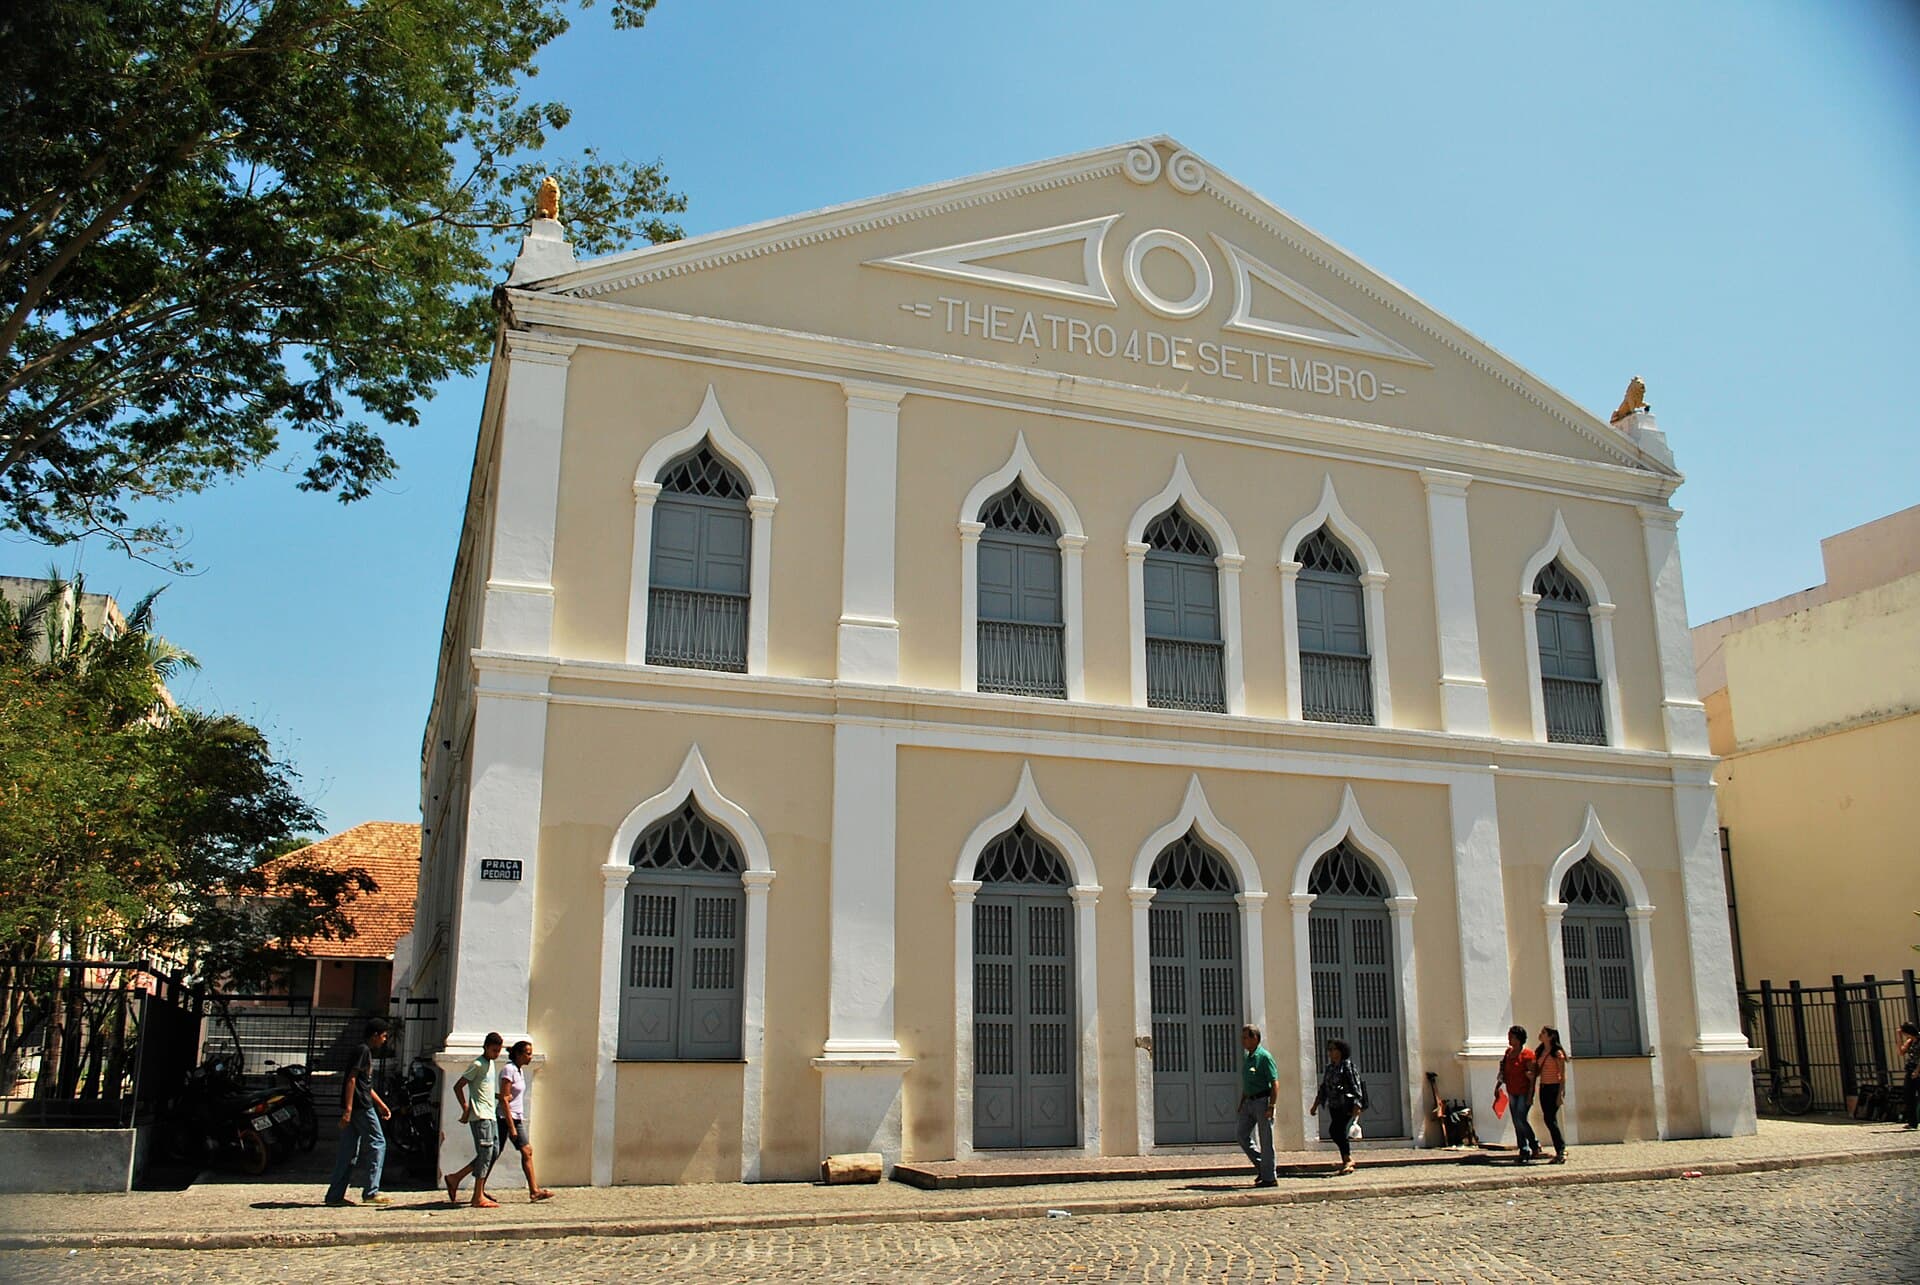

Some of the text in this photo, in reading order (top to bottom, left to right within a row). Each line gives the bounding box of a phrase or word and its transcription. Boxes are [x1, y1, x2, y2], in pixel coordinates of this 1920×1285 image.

[937, 296, 1378, 402] THEATRO 4 DE SETEMBRO
[483, 869, 520, 879] PEDRO II
